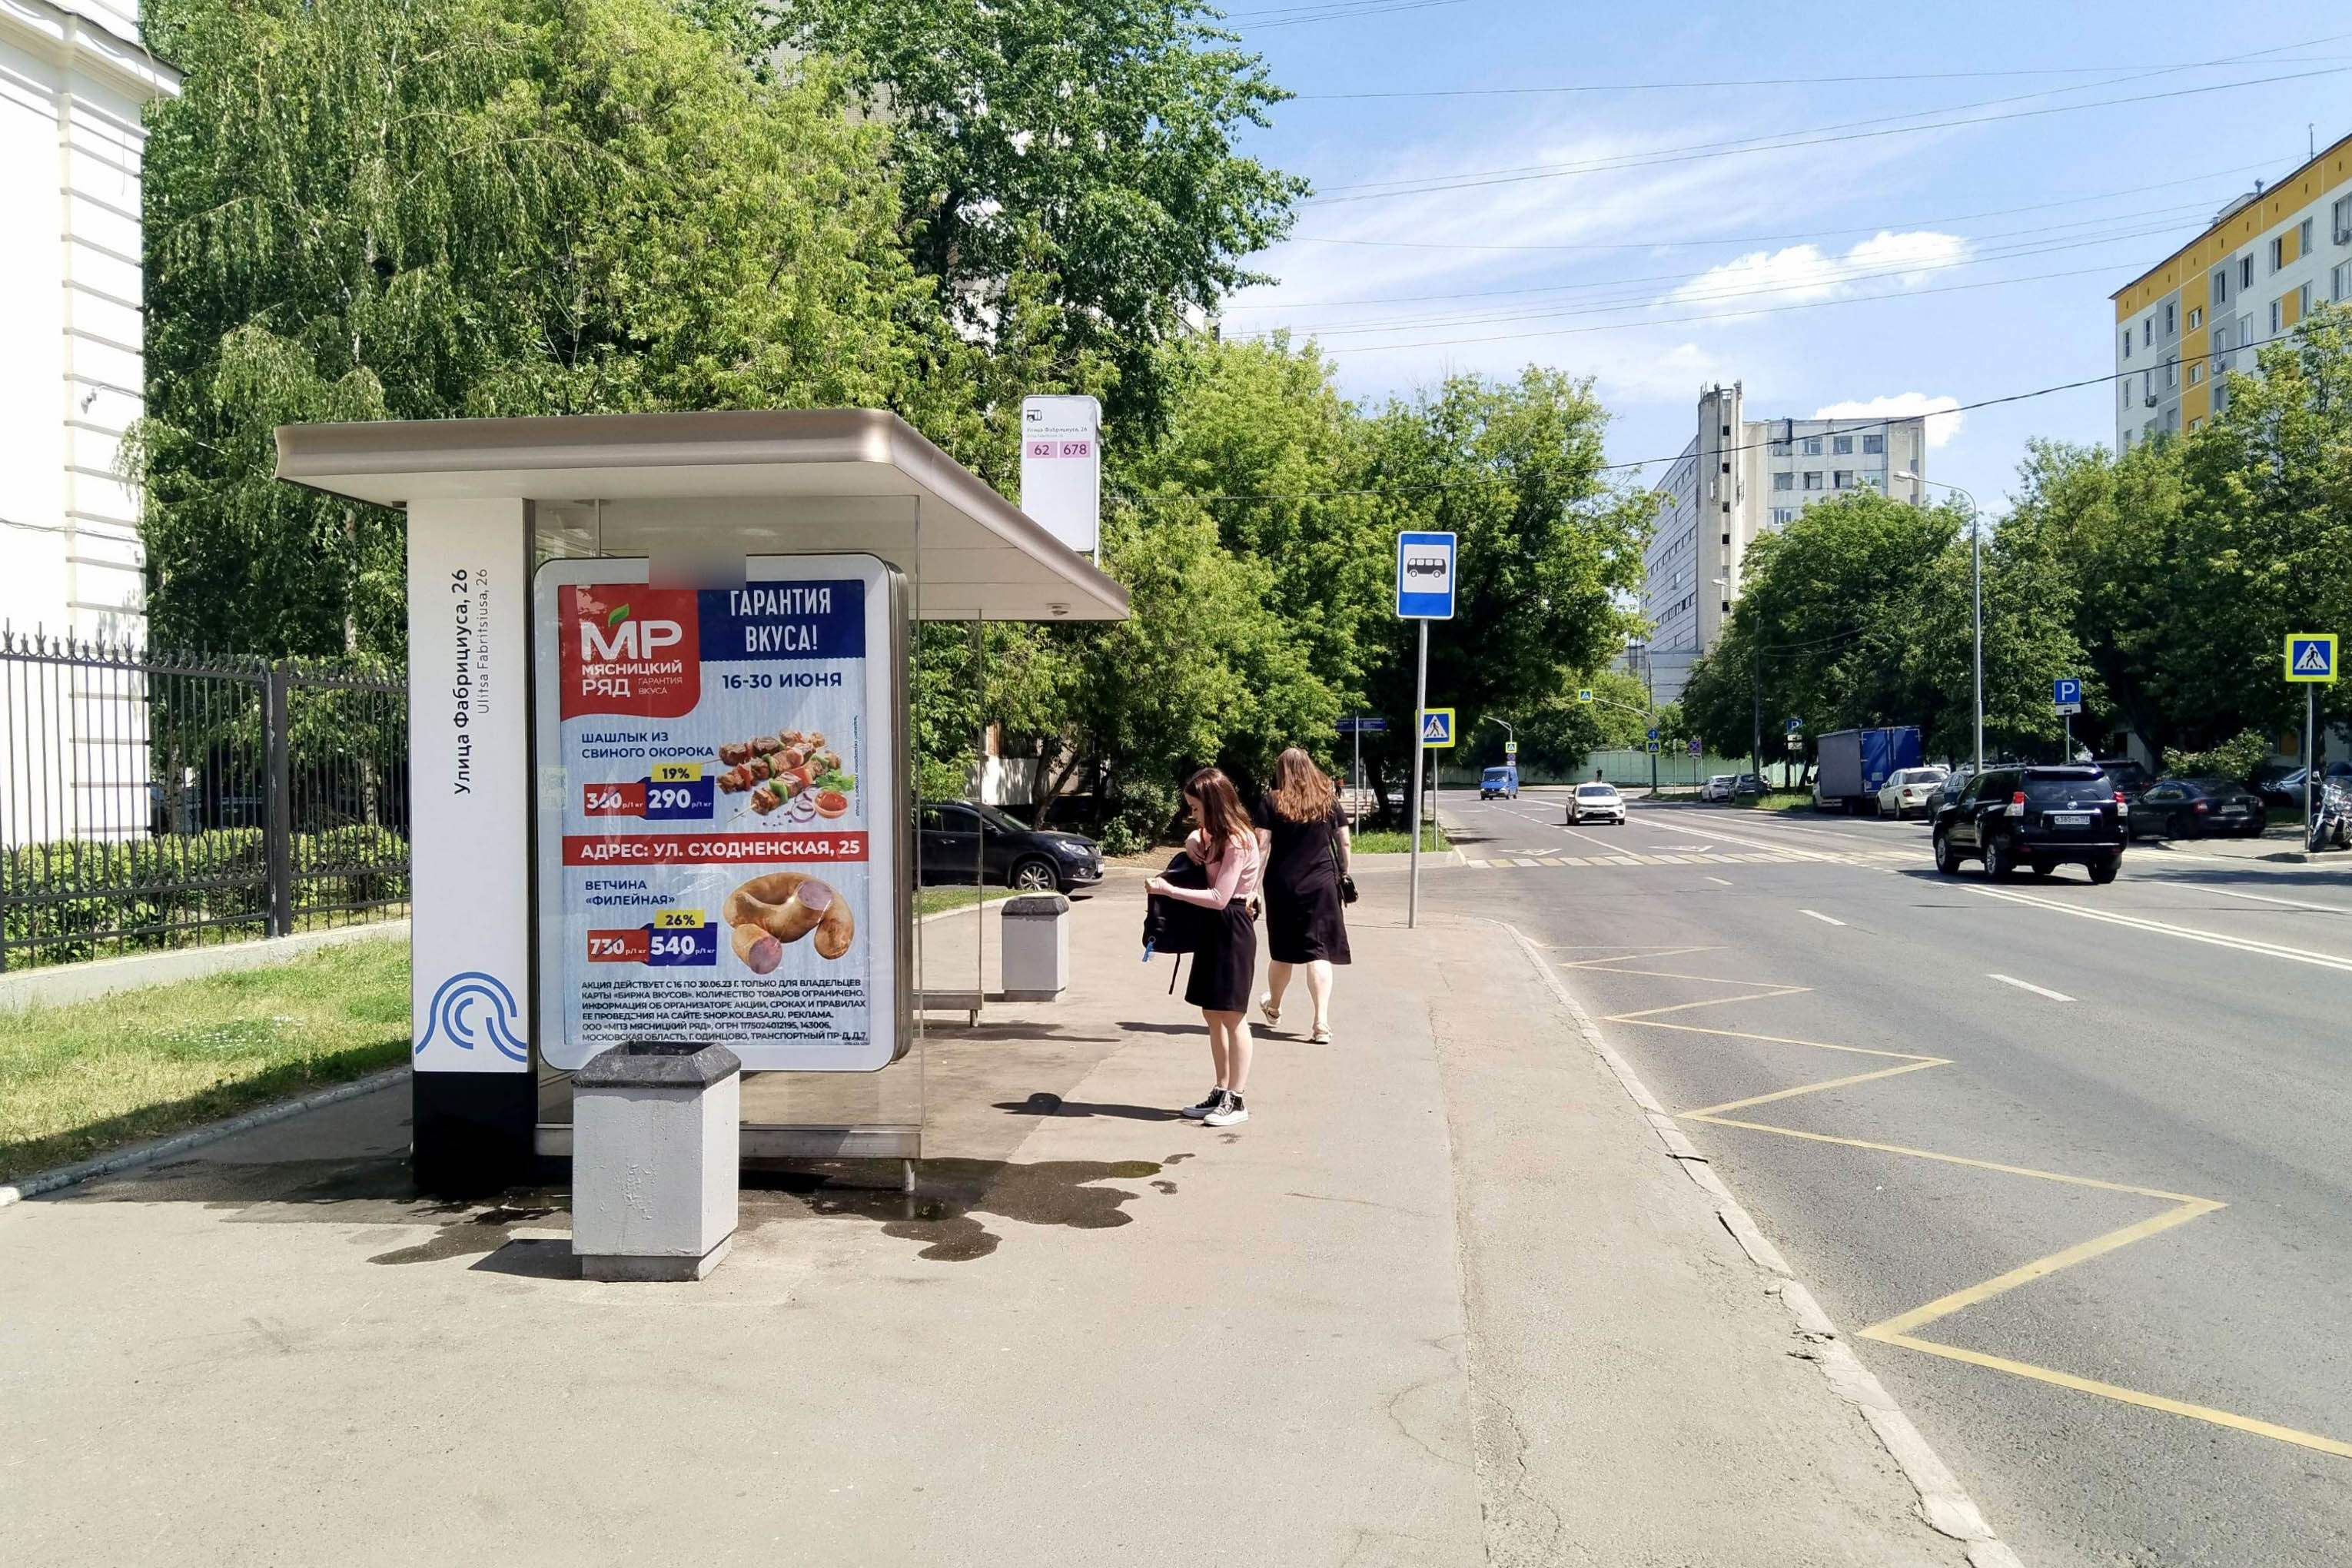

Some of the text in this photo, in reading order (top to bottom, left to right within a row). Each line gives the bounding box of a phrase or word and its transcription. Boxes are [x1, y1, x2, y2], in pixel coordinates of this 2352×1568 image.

[1035, 444, 1049, 455] 62
[1064, 443, 1087, 455] 678
[730, 588, 831, 616] ГАРАНТИЯ
[476, 569, 490, 714] Ulitsa Fabritsiusa, 26
[746, 624, 818, 653] ВКУСА!
[582, 659, 682, 675] МЯСНИЦКИЙ
[452, 569, 472, 794] Улица Фабрициуса, 26
[638, 676, 683, 685] ГАРАНТИЯ
[723, 673, 842, 689] 16-30 ИЮНЯ
[583, 679, 630, 698] РЯД
[638, 686, 668, 695] ВКУСА
[2061, 682, 2075, 701] P
[582, 733, 669, 743] ШАШЛЫК ИЗ
[582, 746, 714, 759] СВИНОГО ОКОРОКА
[662, 767, 690, 779] 19%
[586, 792, 622, 809] 360
[648, 789, 691, 809] 290
[581, 839, 860, 860] АДРЕС: УЛ. СХОДНЕНСКАЯ, 25
[585, 880, 647, 891] ВЕТЧИНА
[586, 893, 675, 905] «ФИЛЕЙНАЯ»
[665, 914, 696, 926] 26%
[590, 938, 625, 955] 730
[650, 935, 696, 955] 540
[613, 980, 664, 989] ДЕЙСТВУЕТ
[779, 980, 797, 988] ДЛЯ
[800, 979, 861, 988] ВЛАДЕЛЬЦЕВ
[671, 1011, 702, 1019] САЙТЕ:
[630, 1022, 687, 1031] МЯСНИЦКИЙ
[696, 1032, 749, 1041] ОДИНЦОВО,
[751, 1031, 825, 1040] ТРАНСПОРТНЫЙ
